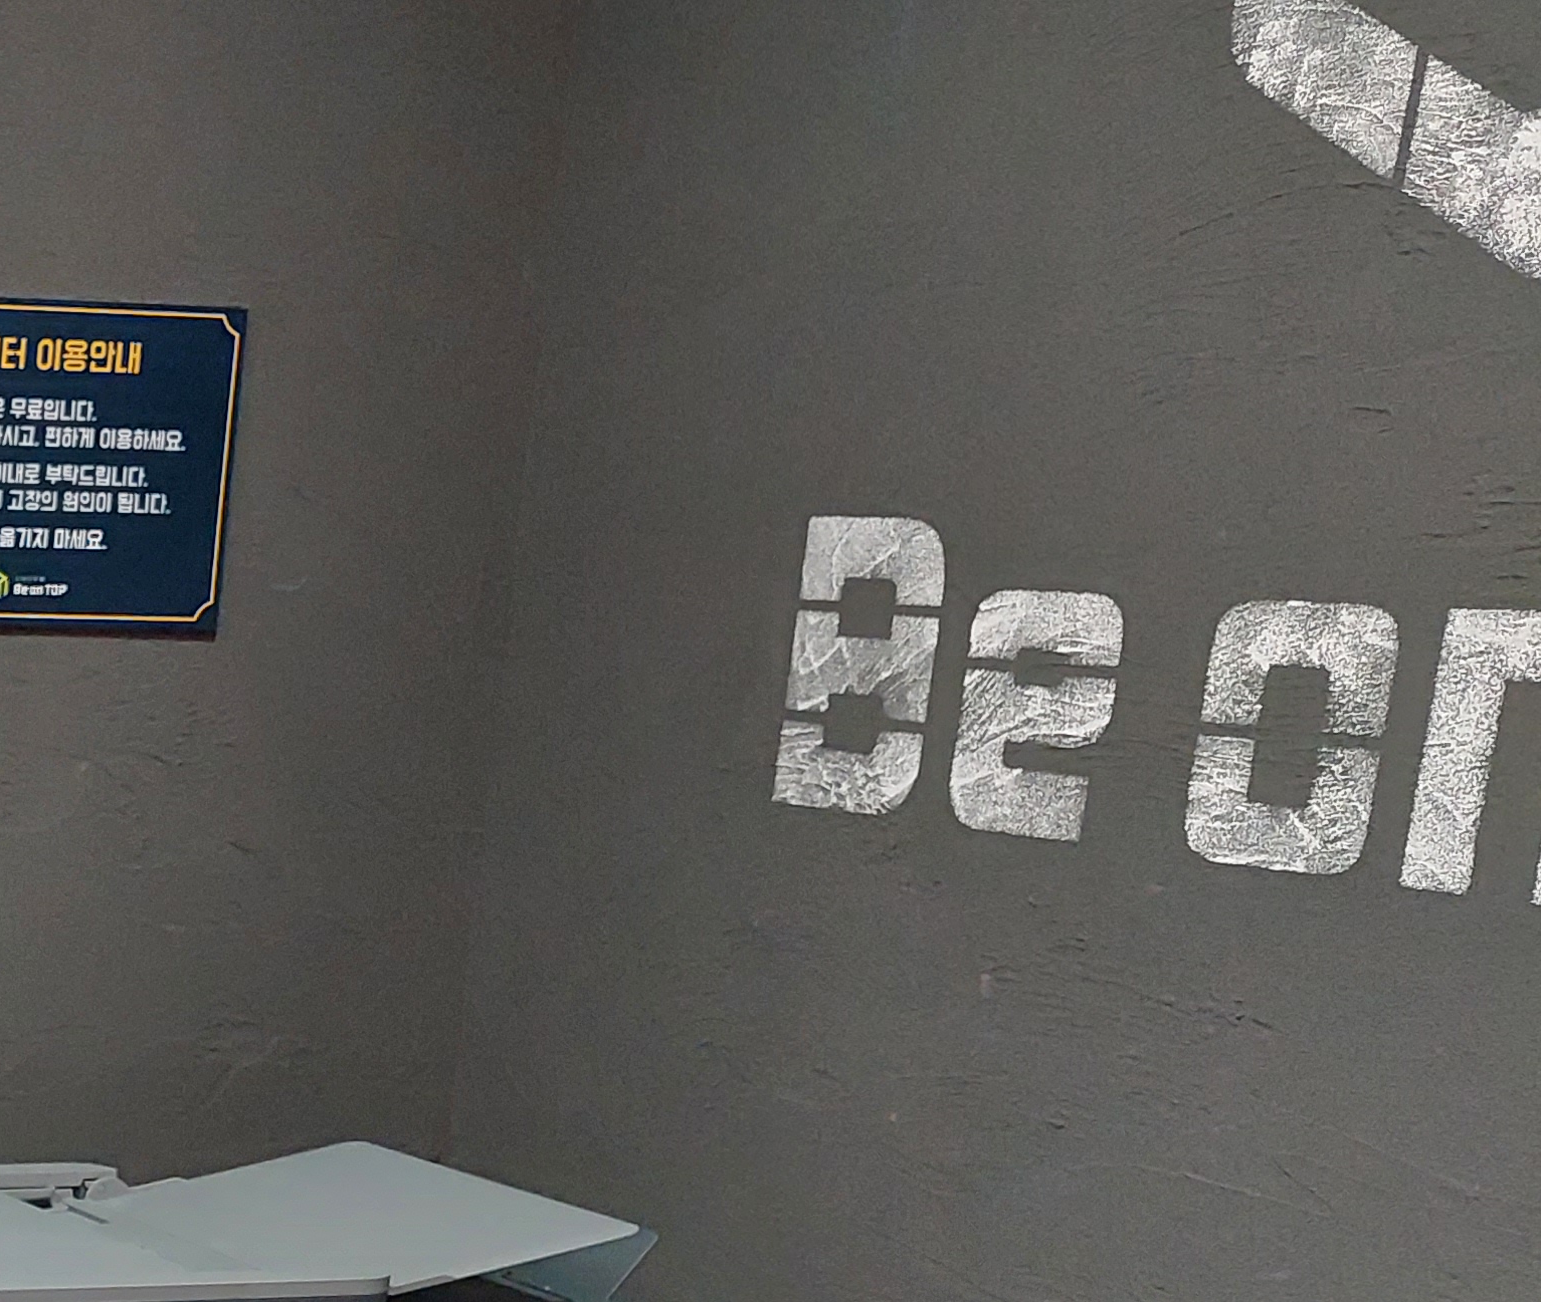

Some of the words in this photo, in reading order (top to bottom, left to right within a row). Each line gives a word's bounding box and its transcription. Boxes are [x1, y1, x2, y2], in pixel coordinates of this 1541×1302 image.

[36, 338, 143, 375] 이용안내
[9, 398, 98, 422] 무료입니다.
[44, 426, 96, 449] 편하게
[99, 428, 187, 452] 이용하세요.
[44, 463, 150, 488] 부탁드립니다.
[6, 489, 58, 512] 고장의
[62, 490, 113, 514] 원인이
[117, 491, 173, 515] 됩니다.
[52, 527, 109, 551] 마세요.
[772, 515, 1125, 844] Be
